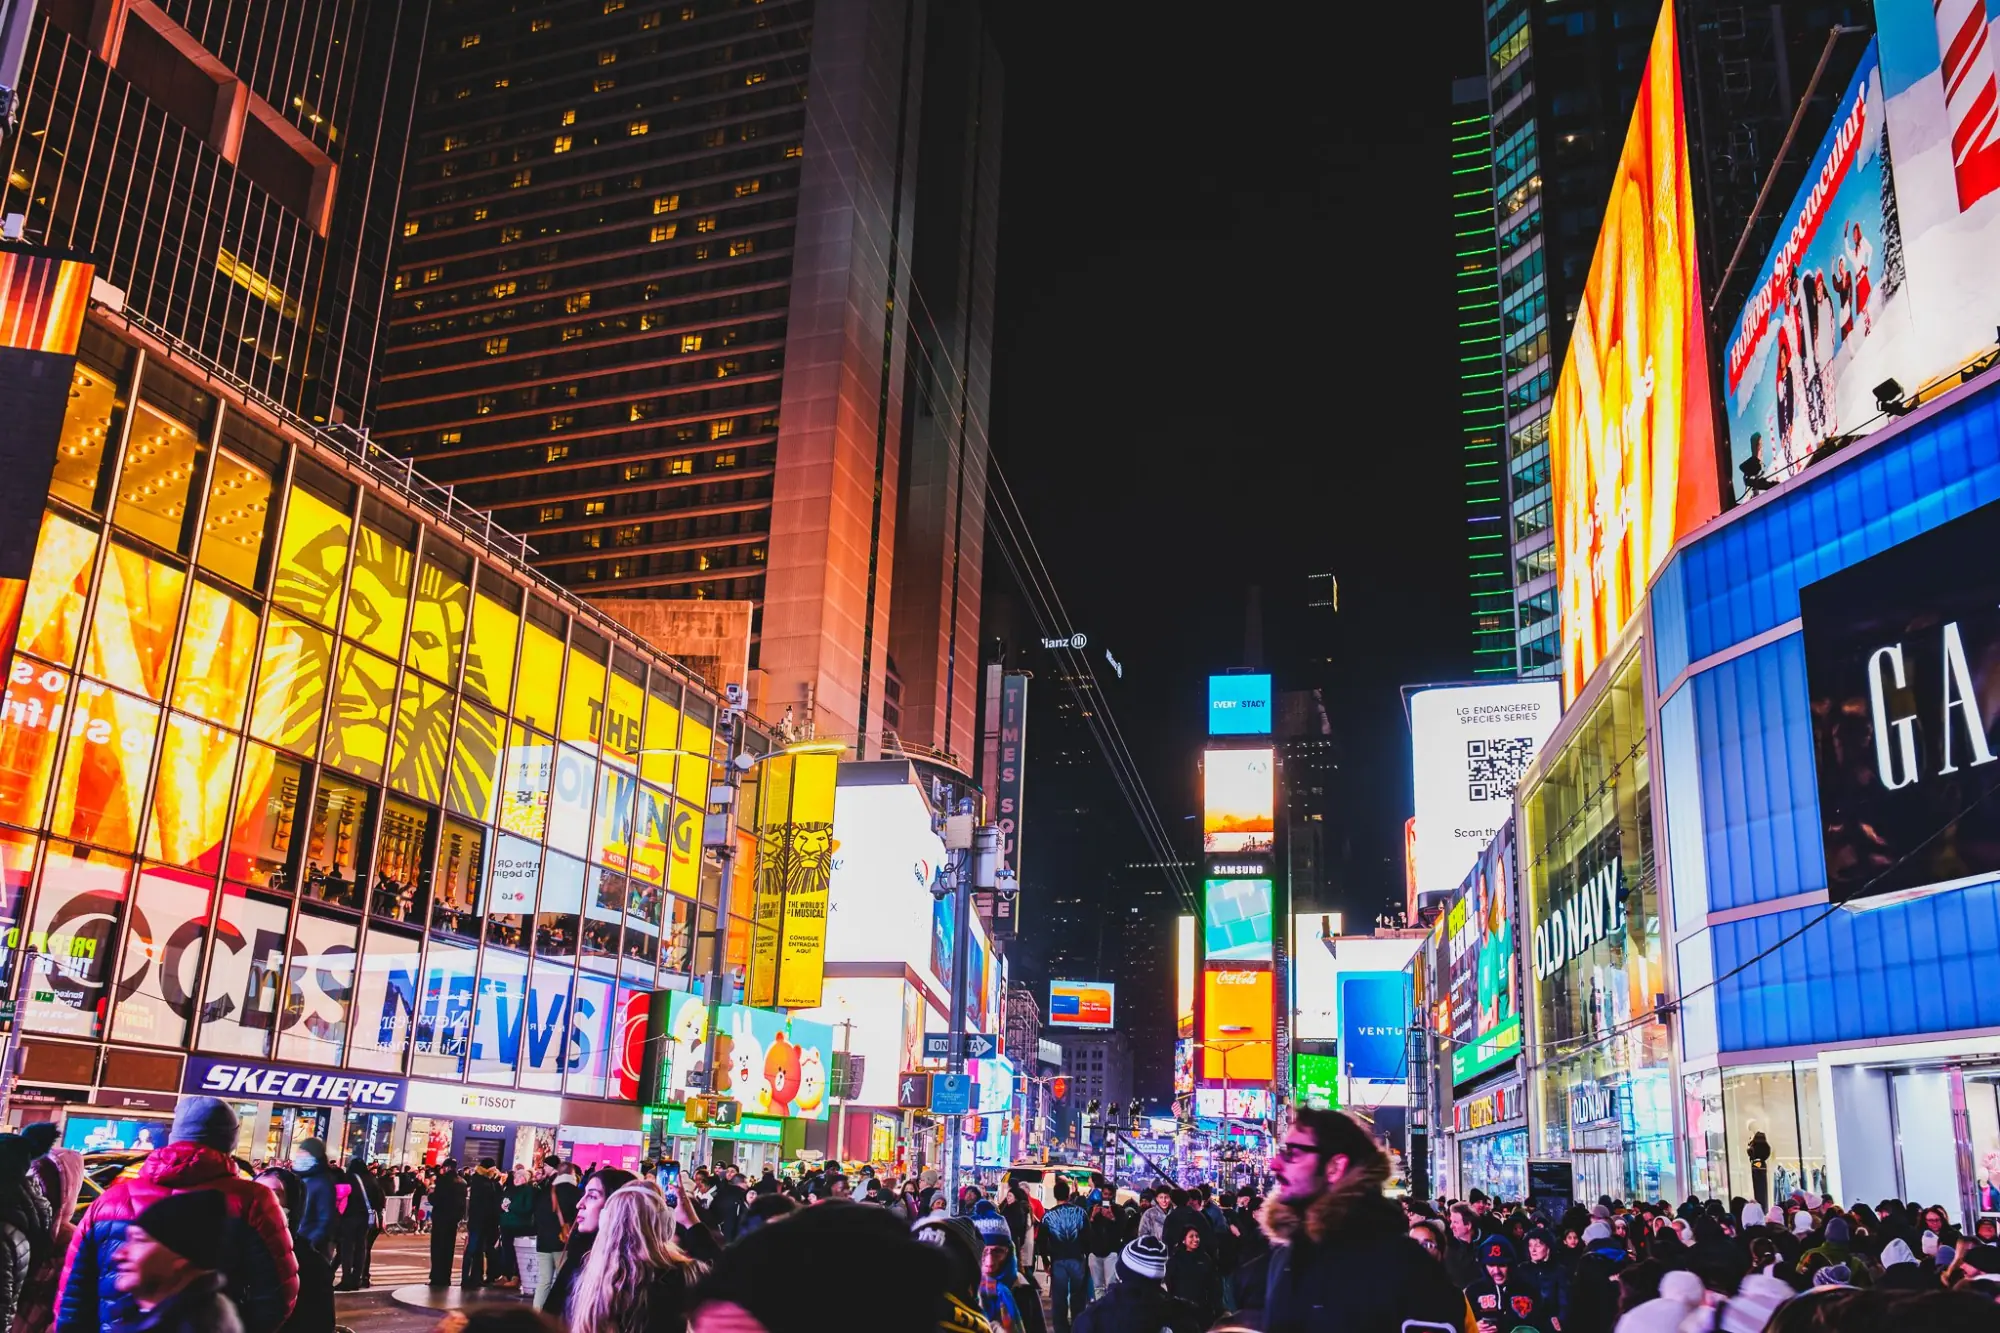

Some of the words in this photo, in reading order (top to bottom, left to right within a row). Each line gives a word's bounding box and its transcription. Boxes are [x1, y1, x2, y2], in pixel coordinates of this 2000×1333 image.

[1731, 272, 1775, 374] Holiday
[1774, 81, 1867, 287] Spectacular!
[1213, 700, 1237, 709] EVERY
[1241, 700, 1266, 708] STACY
[1456, 707, 1470, 716] LG
[1474, 703, 1541, 715] ENDANGERED
[588, 696, 639, 751] THE
[1460, 714, 1501, 724] SPECIES
[1504, 712, 1538, 722] SERIES
[1002, 688, 1018, 783] TIMES
[611, 772, 692, 854] KING
[1454, 829, 1483, 838] Scan
[1213, 865, 1264, 875] SAMSUNG
[788, 901, 799, 909] THE
[800, 901, 825, 909] WORLD'S
[794, 908, 825, 918] MUSICAL
[1535, 909, 1565, 981] OLD
[1566, 856, 1619, 960] NAVY
[159, 915, 359, 1041] CBS
[378, 968, 595, 1074] NEWS
[934, 1040, 949, 1051] ON
[201, 1064, 400, 1105] SKECHERS
[478, 1097, 516, 1109] TISSOT
[1470, 1095, 1493, 1129] GIFTS
[1573, 1097, 1589, 1124] OLD
[1587, 1089, 1610, 1122] NAVY
[481, 1124, 506, 1133] TISSOT
